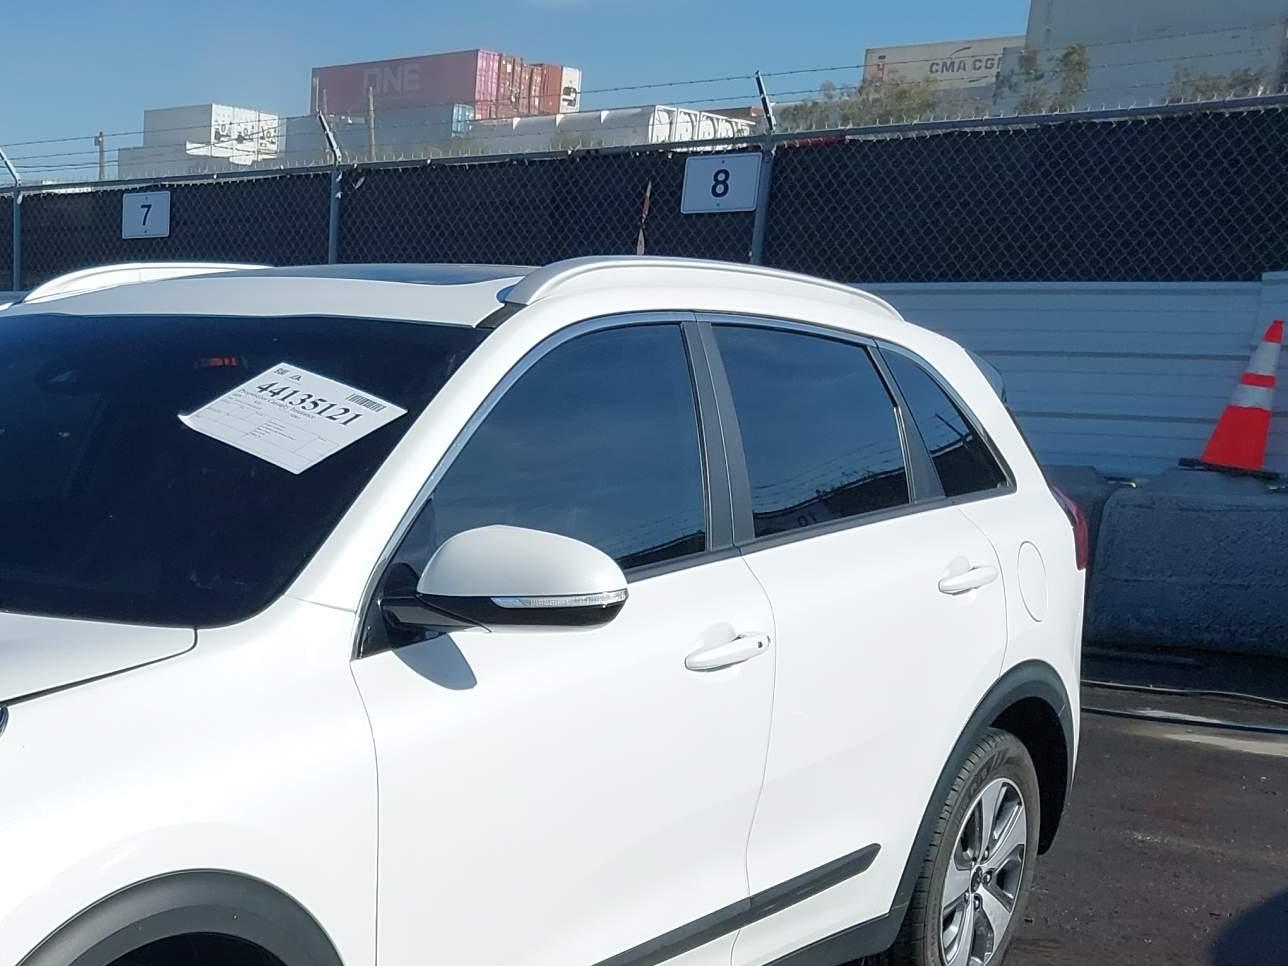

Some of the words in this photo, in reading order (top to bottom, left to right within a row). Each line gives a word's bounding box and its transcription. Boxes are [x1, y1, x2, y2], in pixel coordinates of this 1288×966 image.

[362, 62, 421, 98] ONE
[929, 60, 967, 74] CMA
[711, 168, 730, 198] 8
[141, 203, 152, 226] 7
[255, 382, 363, 426] 44135121
